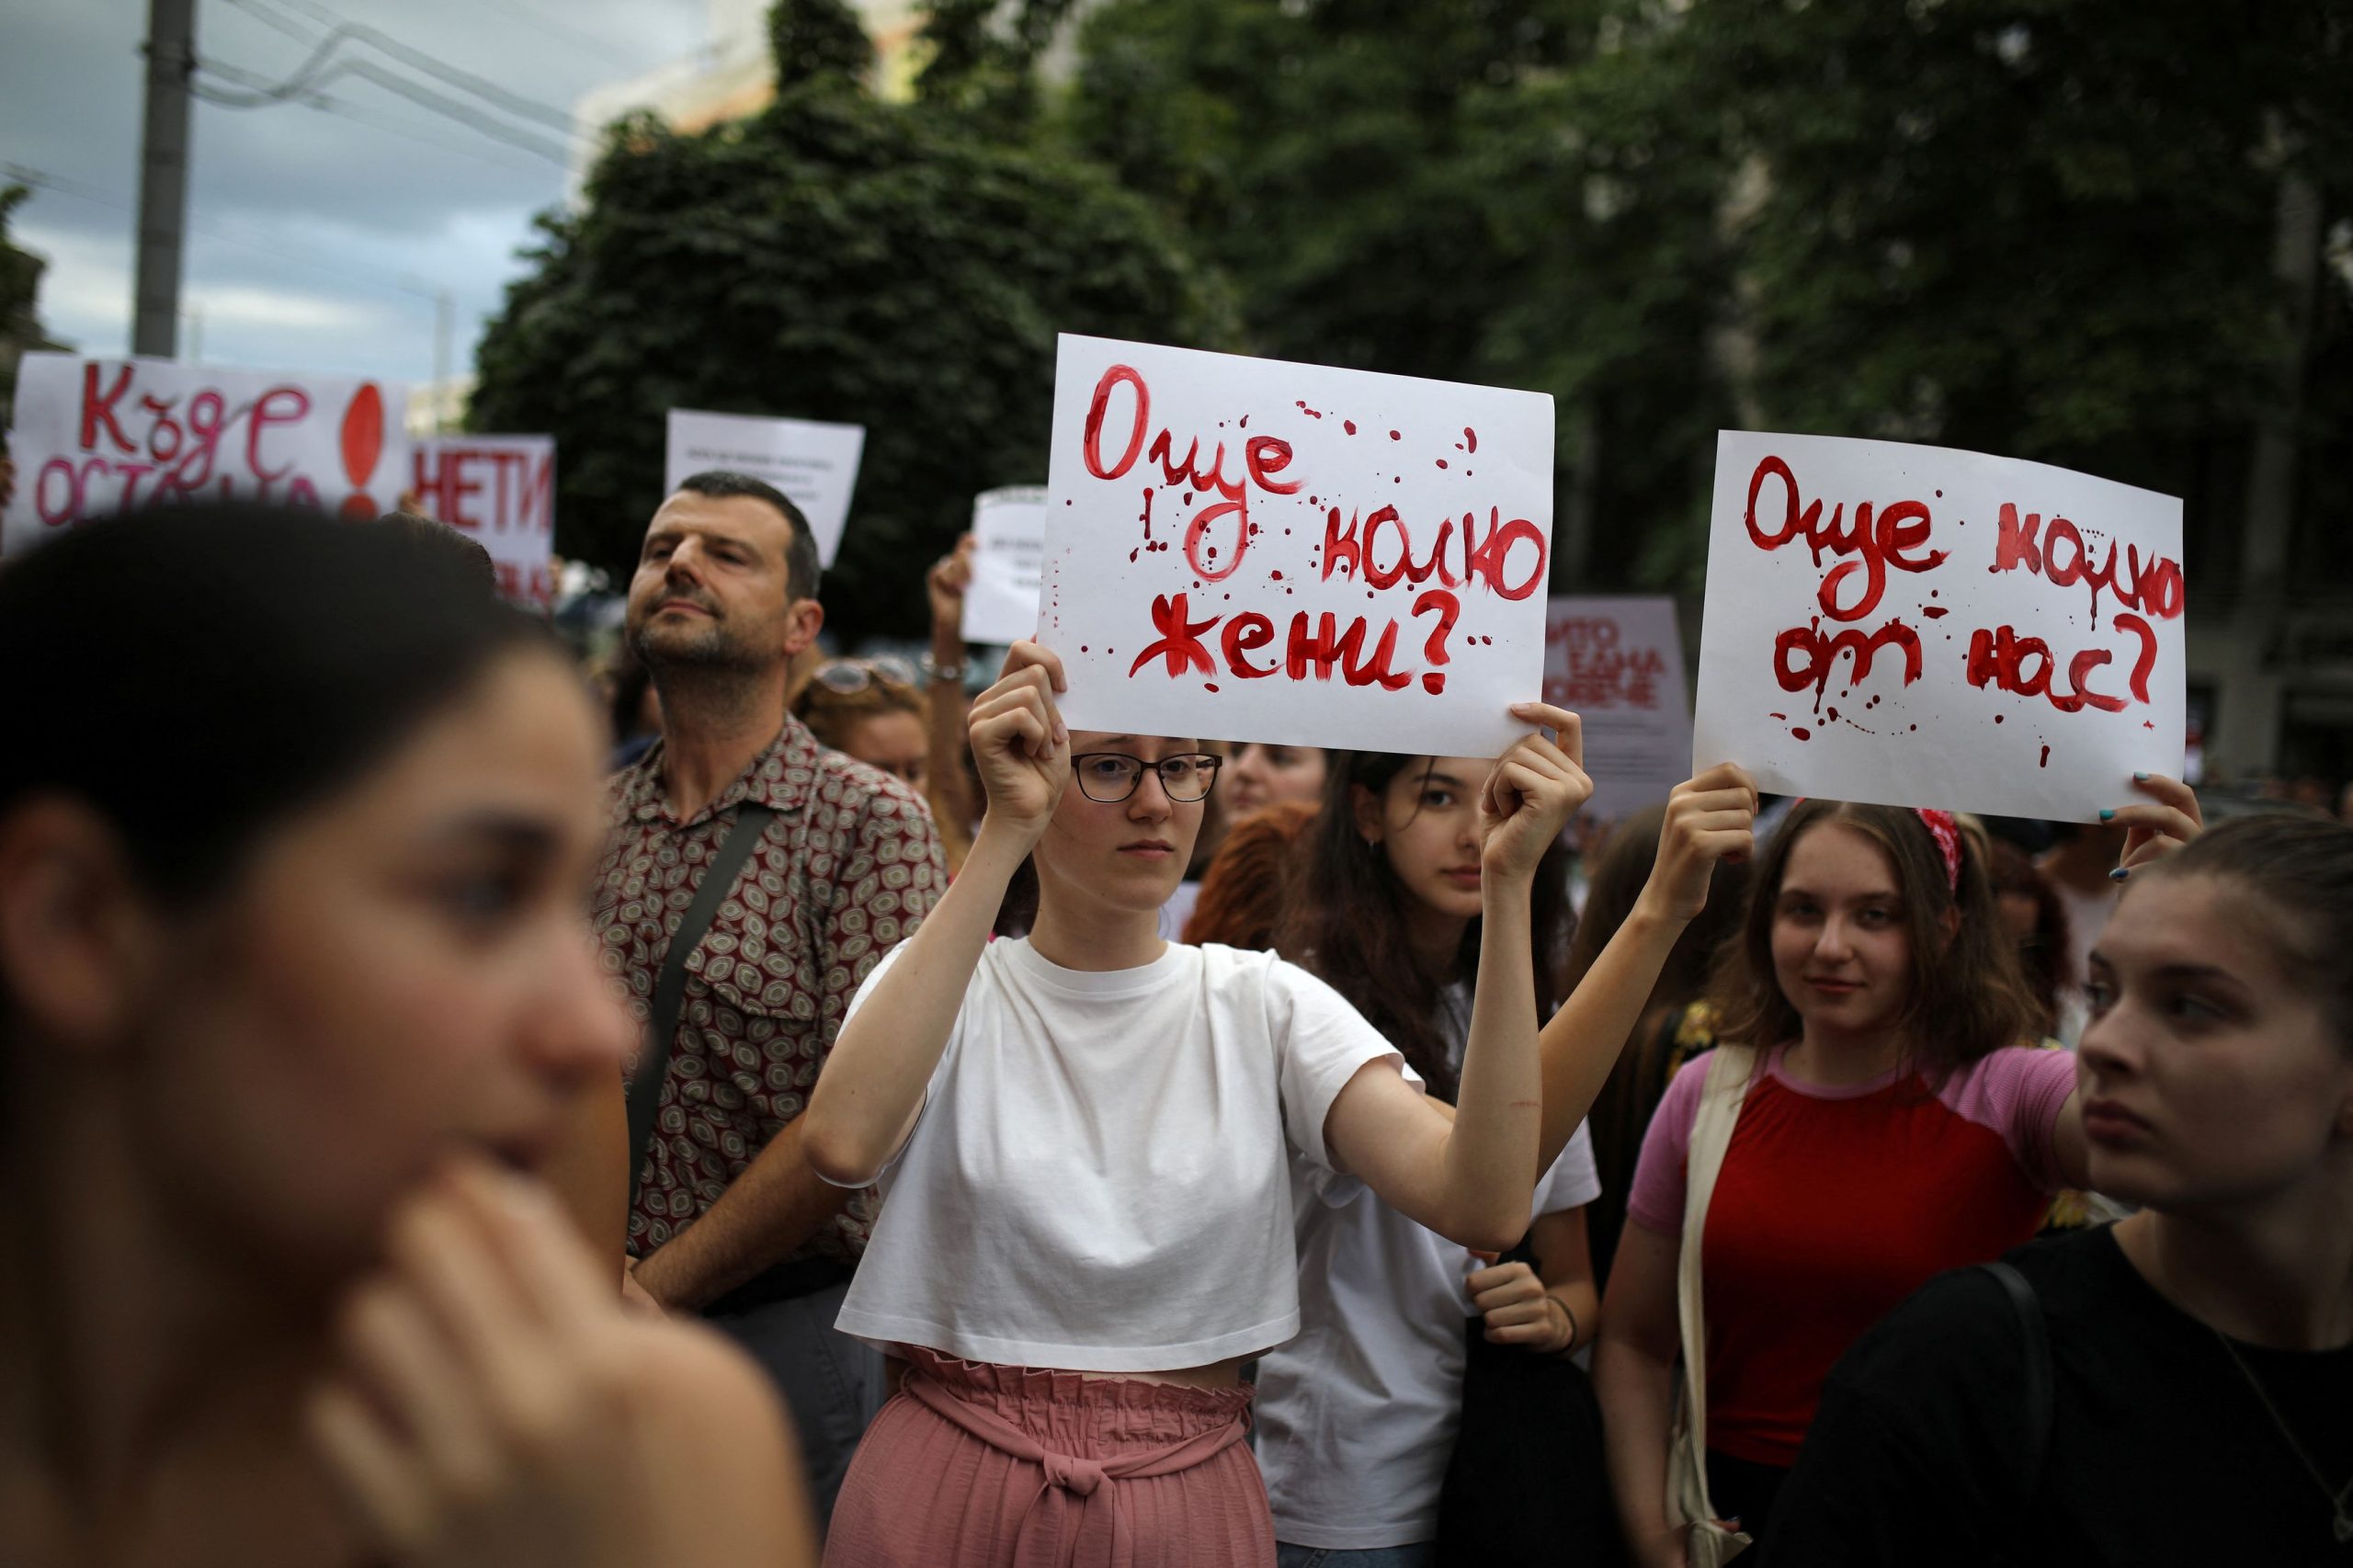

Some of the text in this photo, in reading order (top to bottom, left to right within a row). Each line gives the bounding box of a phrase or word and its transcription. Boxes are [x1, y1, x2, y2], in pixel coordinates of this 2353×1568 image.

[1083, 364, 1547, 602] Още колко
[1745, 455, 2186, 622] Още колко
[1774, 613, 2158, 731] от нас?
